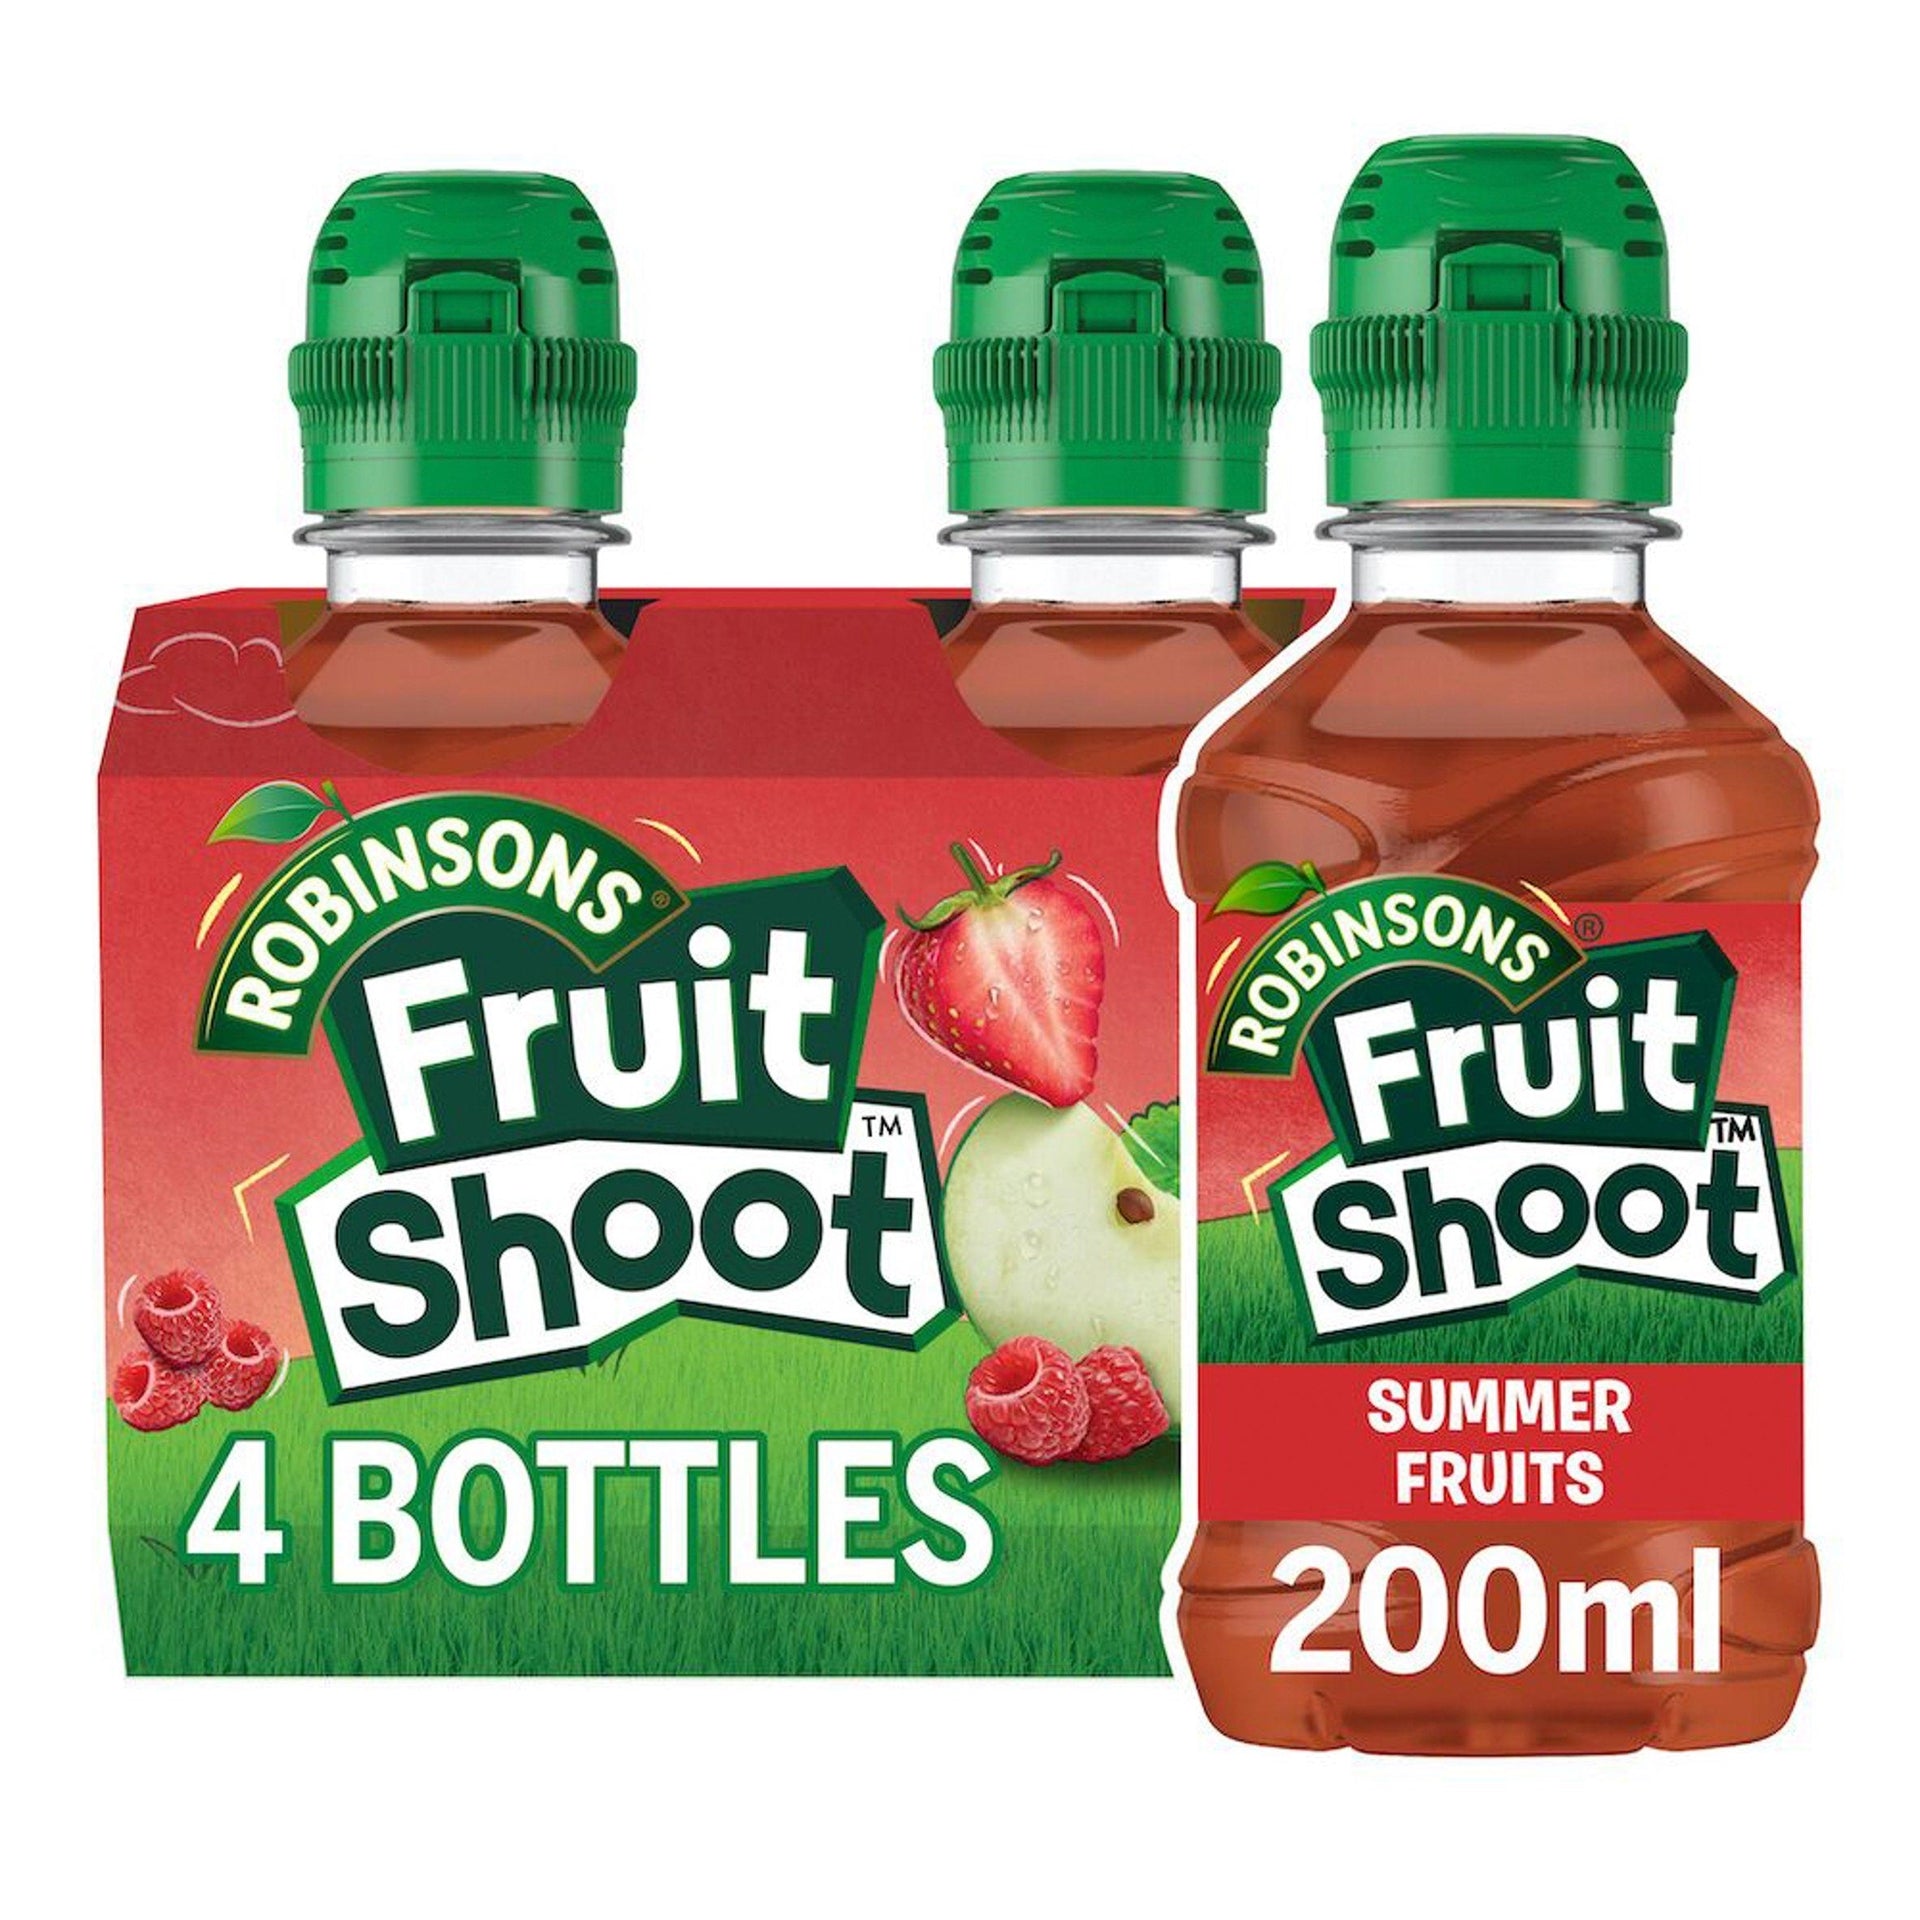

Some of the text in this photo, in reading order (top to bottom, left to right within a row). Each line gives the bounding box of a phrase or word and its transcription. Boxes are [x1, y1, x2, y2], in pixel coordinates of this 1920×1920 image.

[226, 816, 642, 1032] ROBINSONS
[1227, 893, 1551, 1058] ROBINSONS
[362, 924, 834, 1143] Fruit
[1334, 974, 1698, 1145] Fruit
[861, 1115, 903, 1137] TM
[1711, 1115, 1756, 1143] TM
[334, 1150, 914, 1358] Shoot
[1312, 1149, 1760, 1310] Shoot
[1366, 1377, 1633, 1434] SUMMER
[1396, 1449, 1605, 1506] FRUITS
[185, 1438, 993, 1587] 4 BOTTLES
[1270, 1544, 1721, 1675] 200ml
